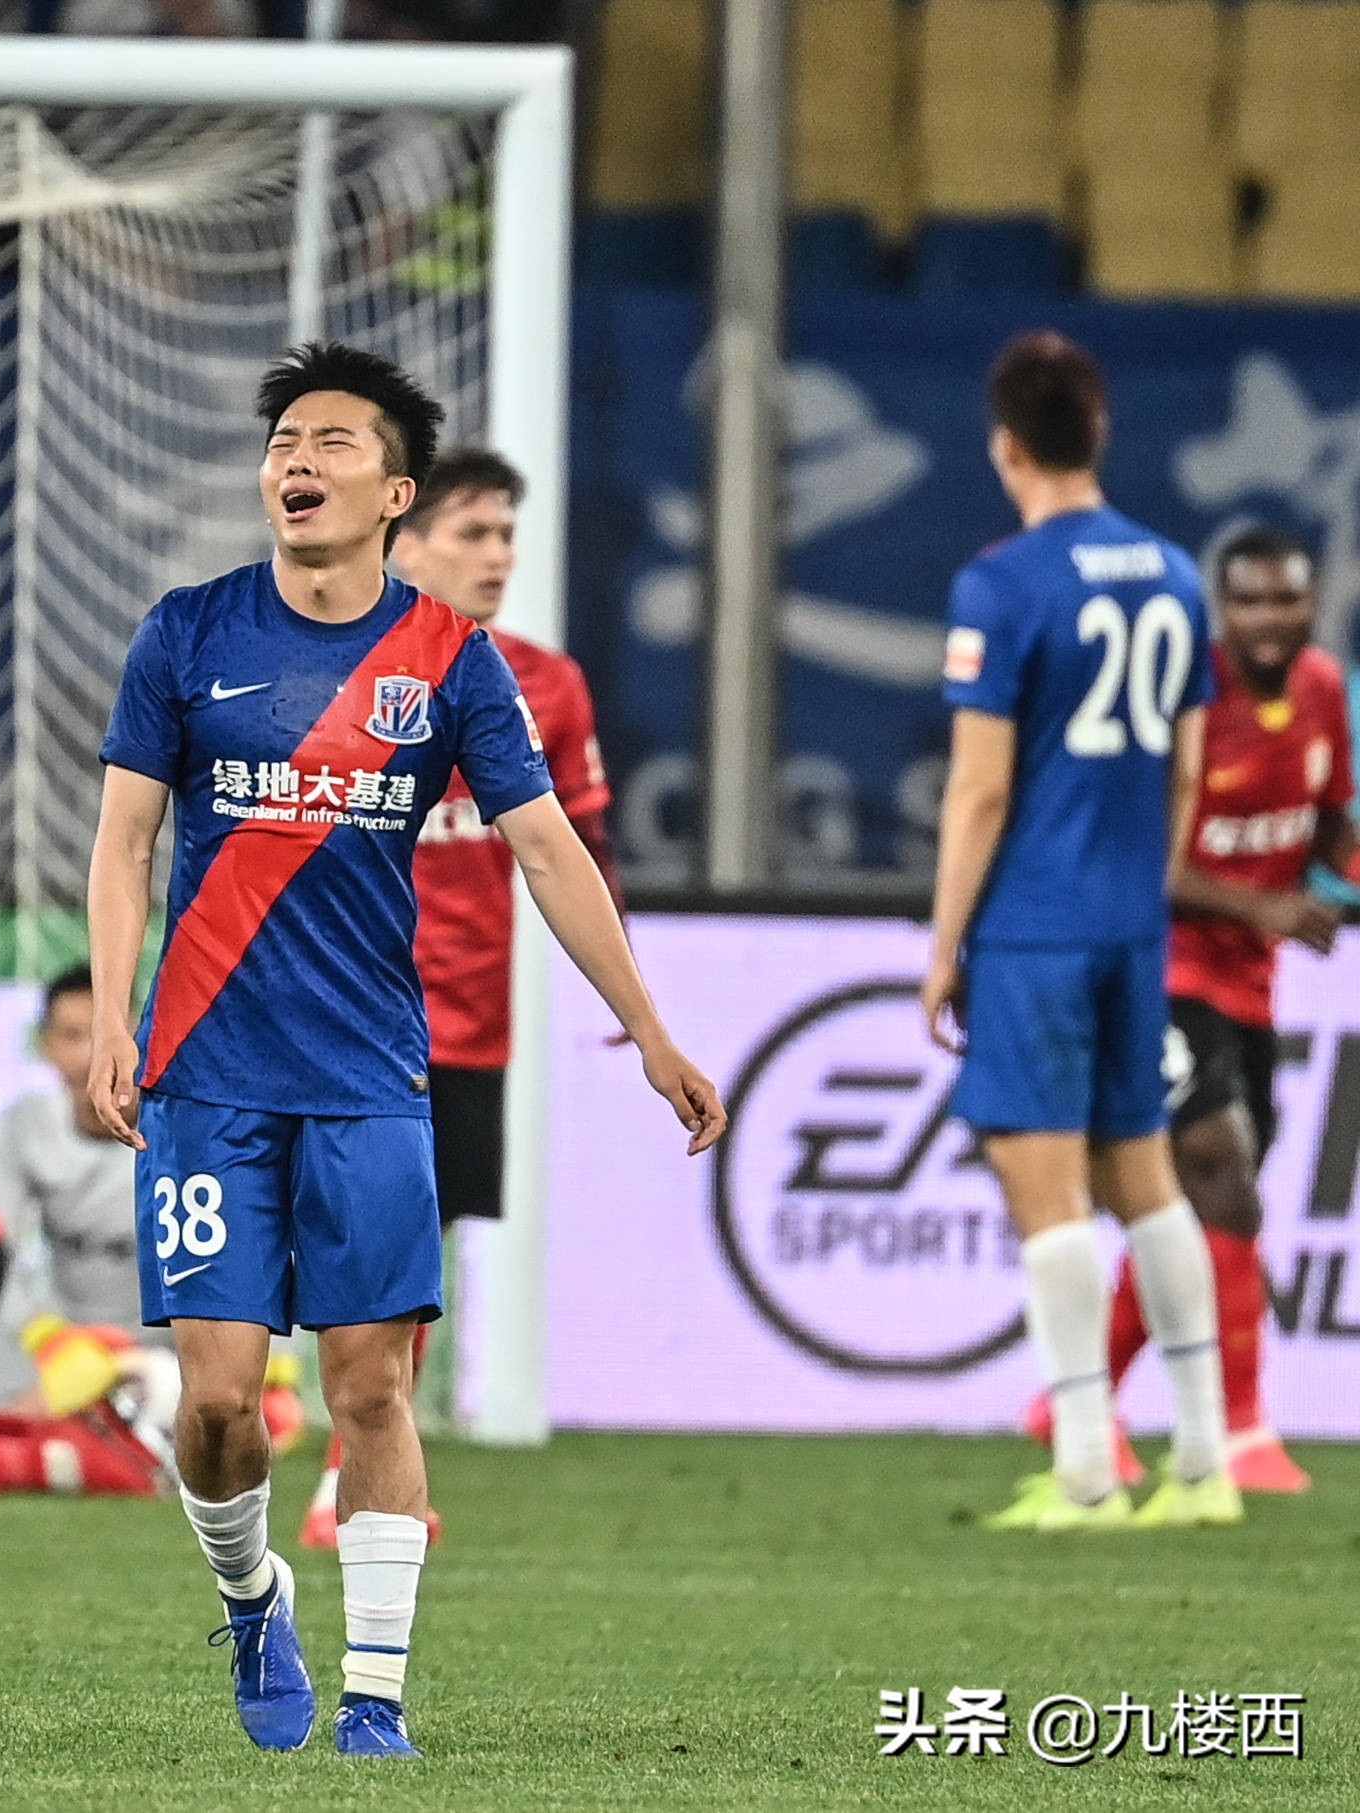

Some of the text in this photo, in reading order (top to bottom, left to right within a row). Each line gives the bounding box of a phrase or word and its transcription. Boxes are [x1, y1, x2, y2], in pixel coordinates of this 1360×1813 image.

[1064, 594, 1194, 757] 20
[212, 758, 416, 812] 绿地大基建
[212, 798, 297, 822] Greenland
[154, 1173, 227, 1259] 38
